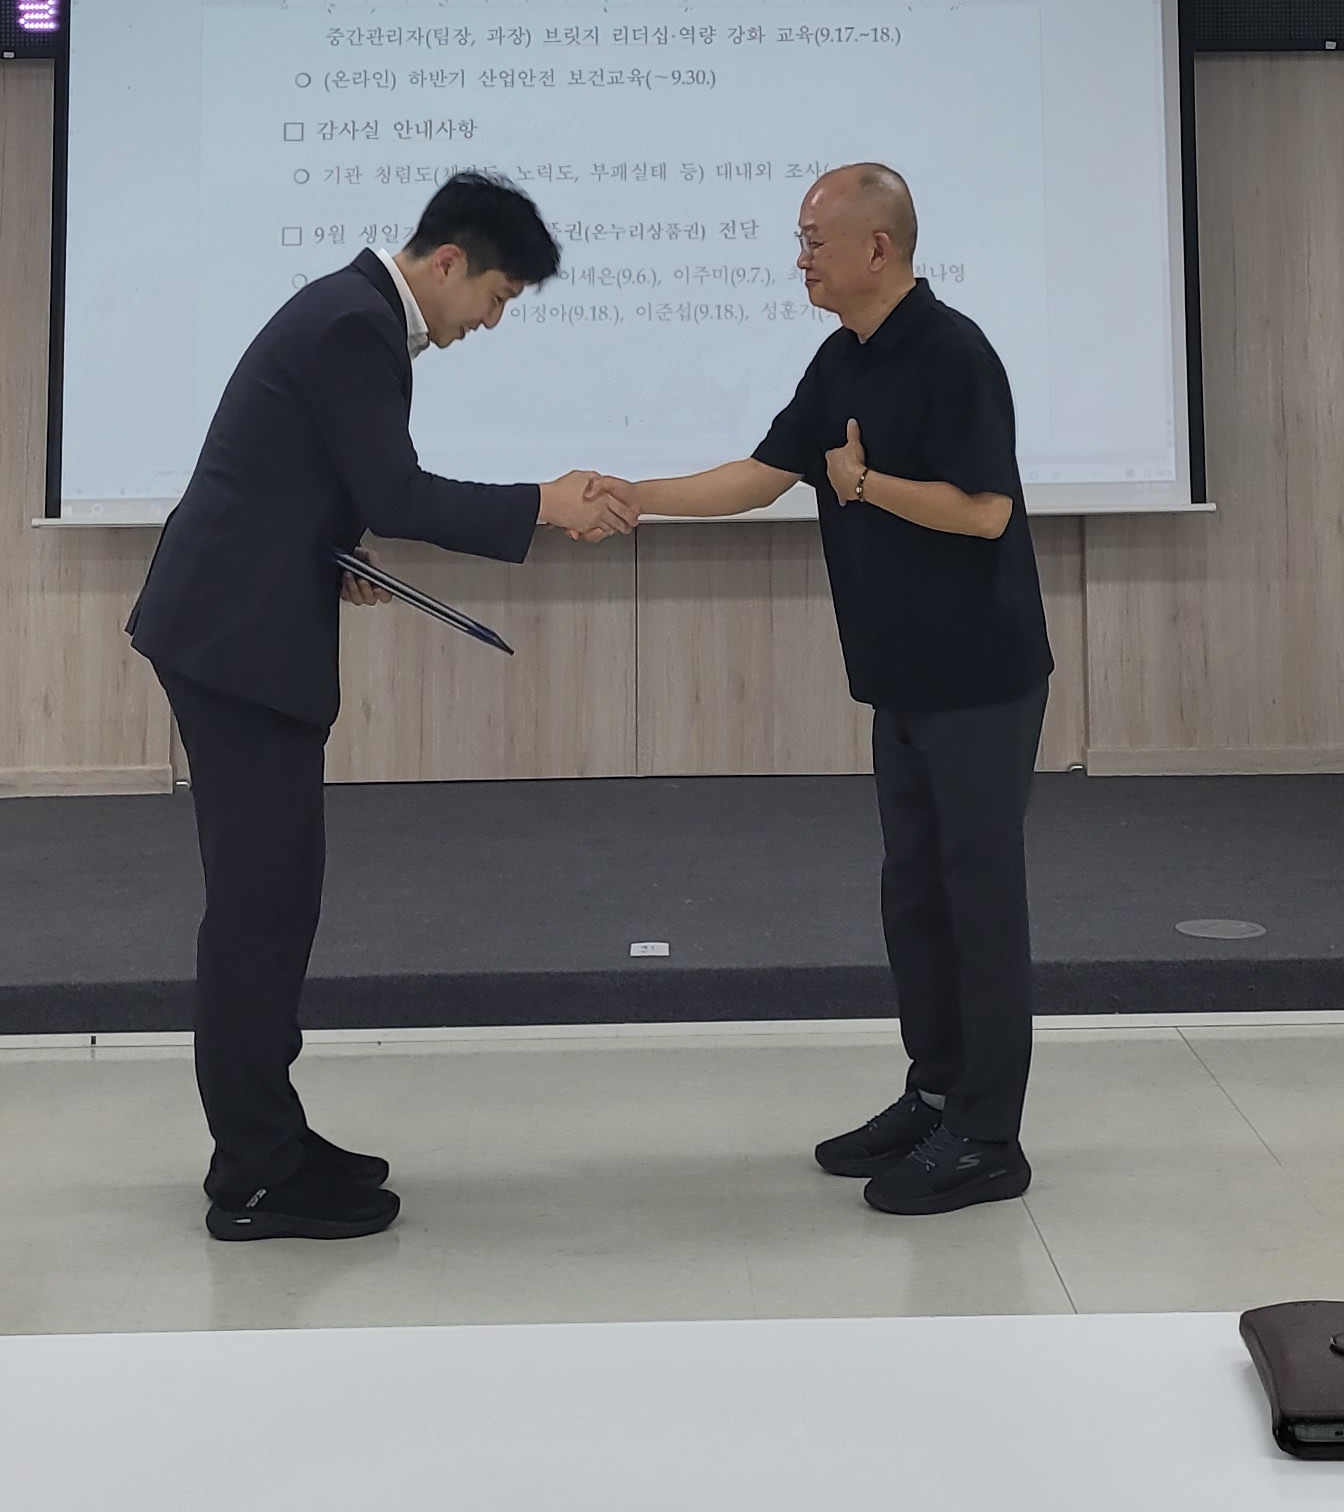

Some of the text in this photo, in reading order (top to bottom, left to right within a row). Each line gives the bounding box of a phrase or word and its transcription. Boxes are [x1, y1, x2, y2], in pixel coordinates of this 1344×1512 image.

[325, 27, 476, 49] 중간관리자(팀장,
[486, 27, 532, 48] 과장)
[543, 26, 599, 46] 브릿지
[726, 25, 765, 45] 강화
[323, 67, 717, 92] (온라인) 하반기 산업안전 보건교육(~9.30.)
[316, 118, 478, 141] 감사실 안내사항
[323, 165, 363, 185] 기관
[516, 163, 580, 184] 노력도,
[590, 162, 667, 183] 부패실태
[679, 162, 704, 185] 등)
[715, 160, 772, 182] 대내외
[314, 224, 346, 245] 9월
[719, 219, 760, 239] 전달
[674, 264, 776, 288] 이주미(9.7.),
